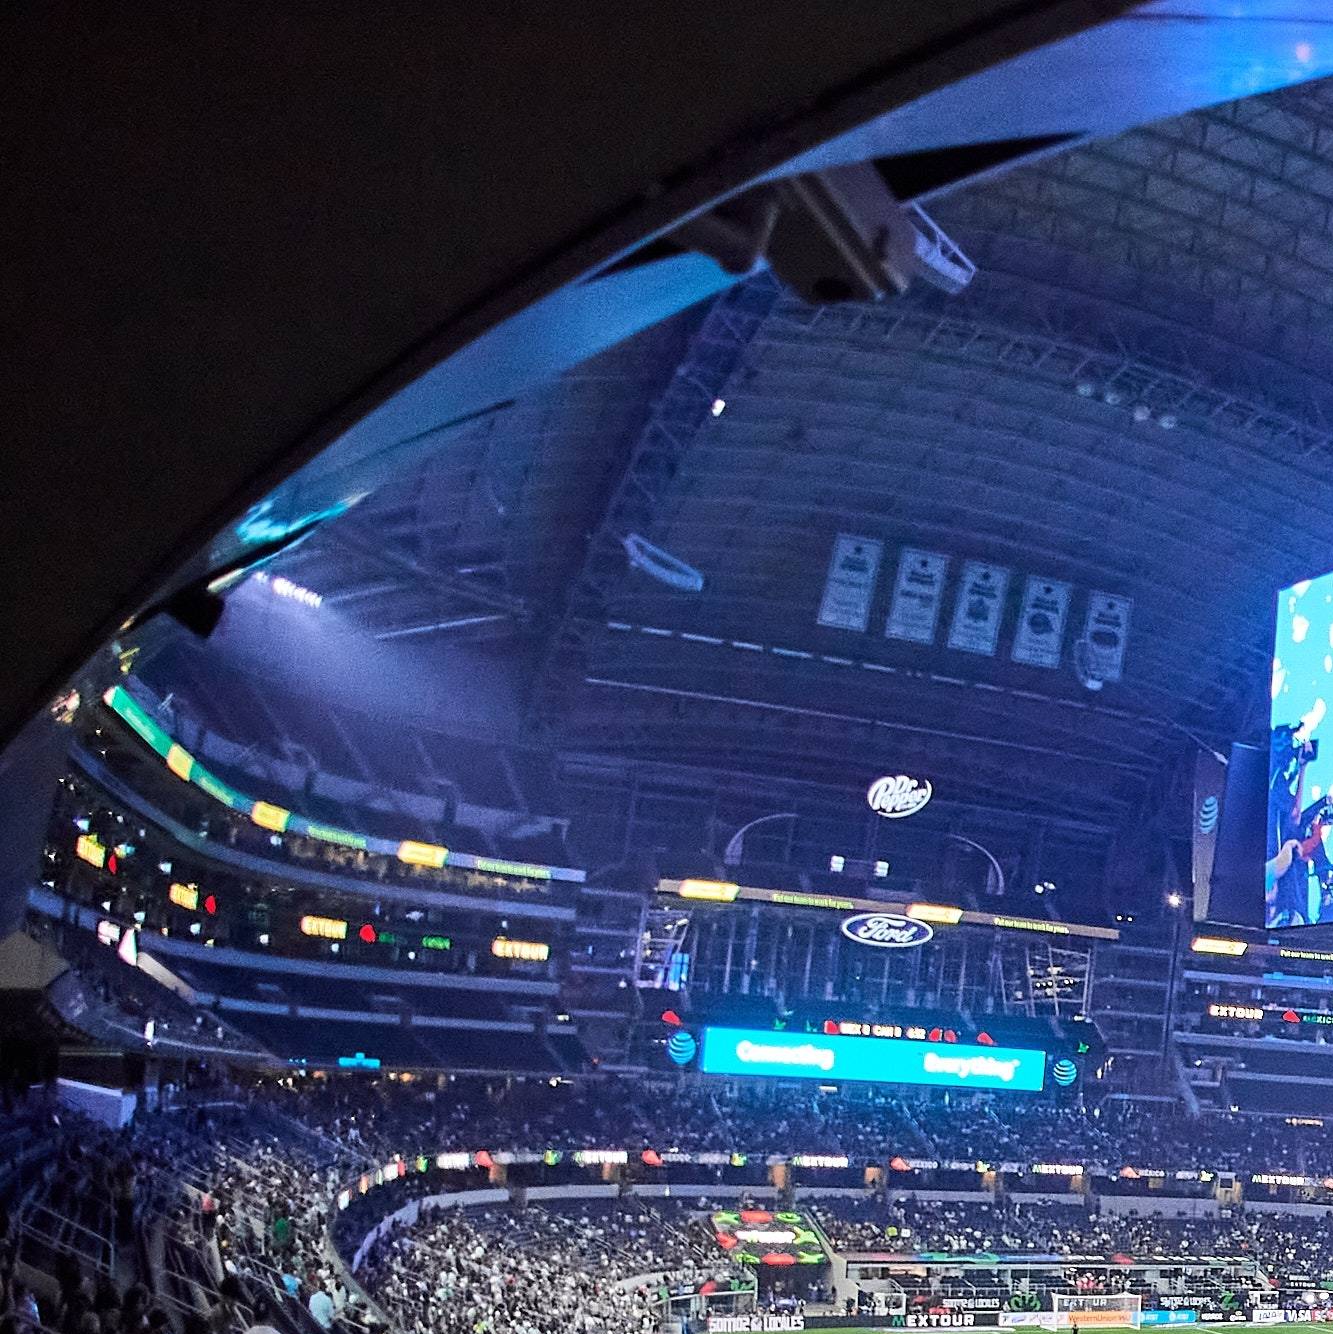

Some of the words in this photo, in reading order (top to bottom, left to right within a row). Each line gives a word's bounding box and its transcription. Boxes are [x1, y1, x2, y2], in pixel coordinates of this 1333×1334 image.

[868, 776, 927, 812] Pepper
[895, 775, 918, 794] Dr
[858, 917, 918, 942] Ford
[892, 1314, 975, 1327] MEXTOUR
